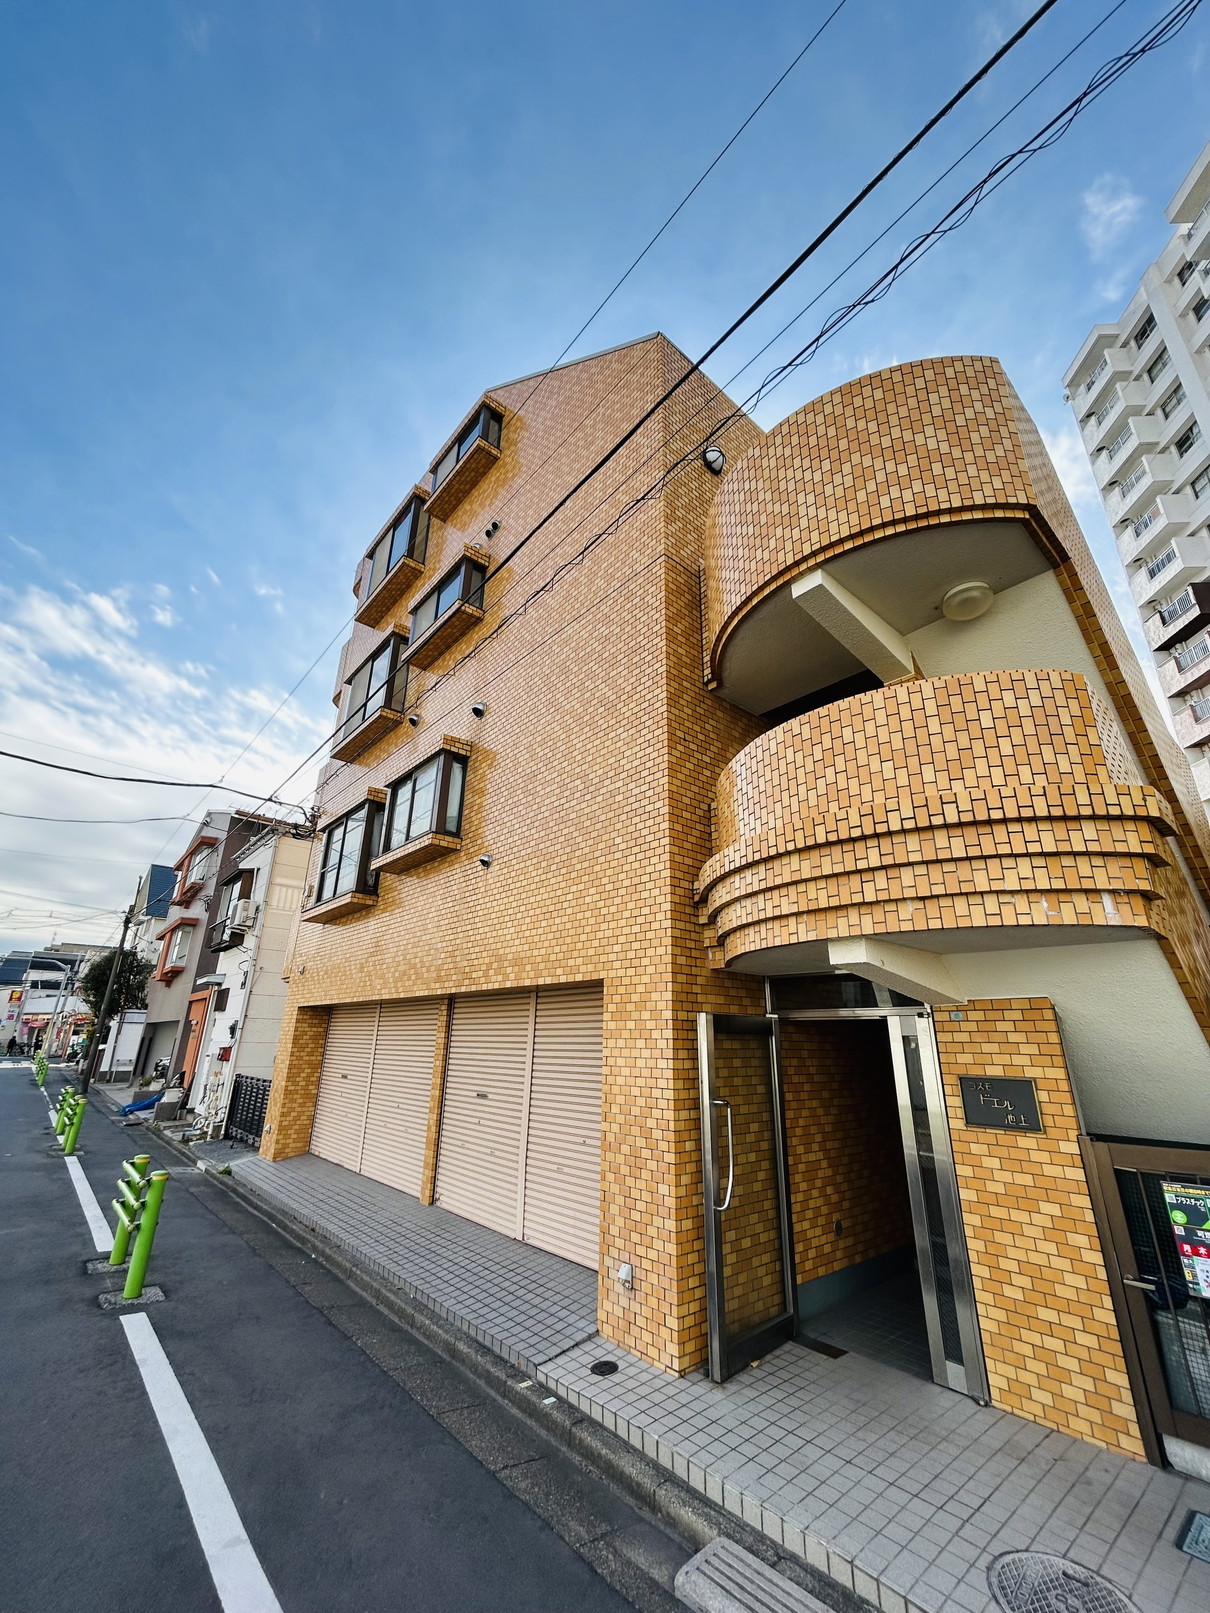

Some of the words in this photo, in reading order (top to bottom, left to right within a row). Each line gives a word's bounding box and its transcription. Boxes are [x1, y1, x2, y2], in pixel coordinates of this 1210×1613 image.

[968, 1081, 992, 1091] コスモ
[980, 1093, 1015, 1111] ドエル
[1005, 1112, 1030, 1126] 池上
[1176, 1196, 1204, 1207] プラスチック
